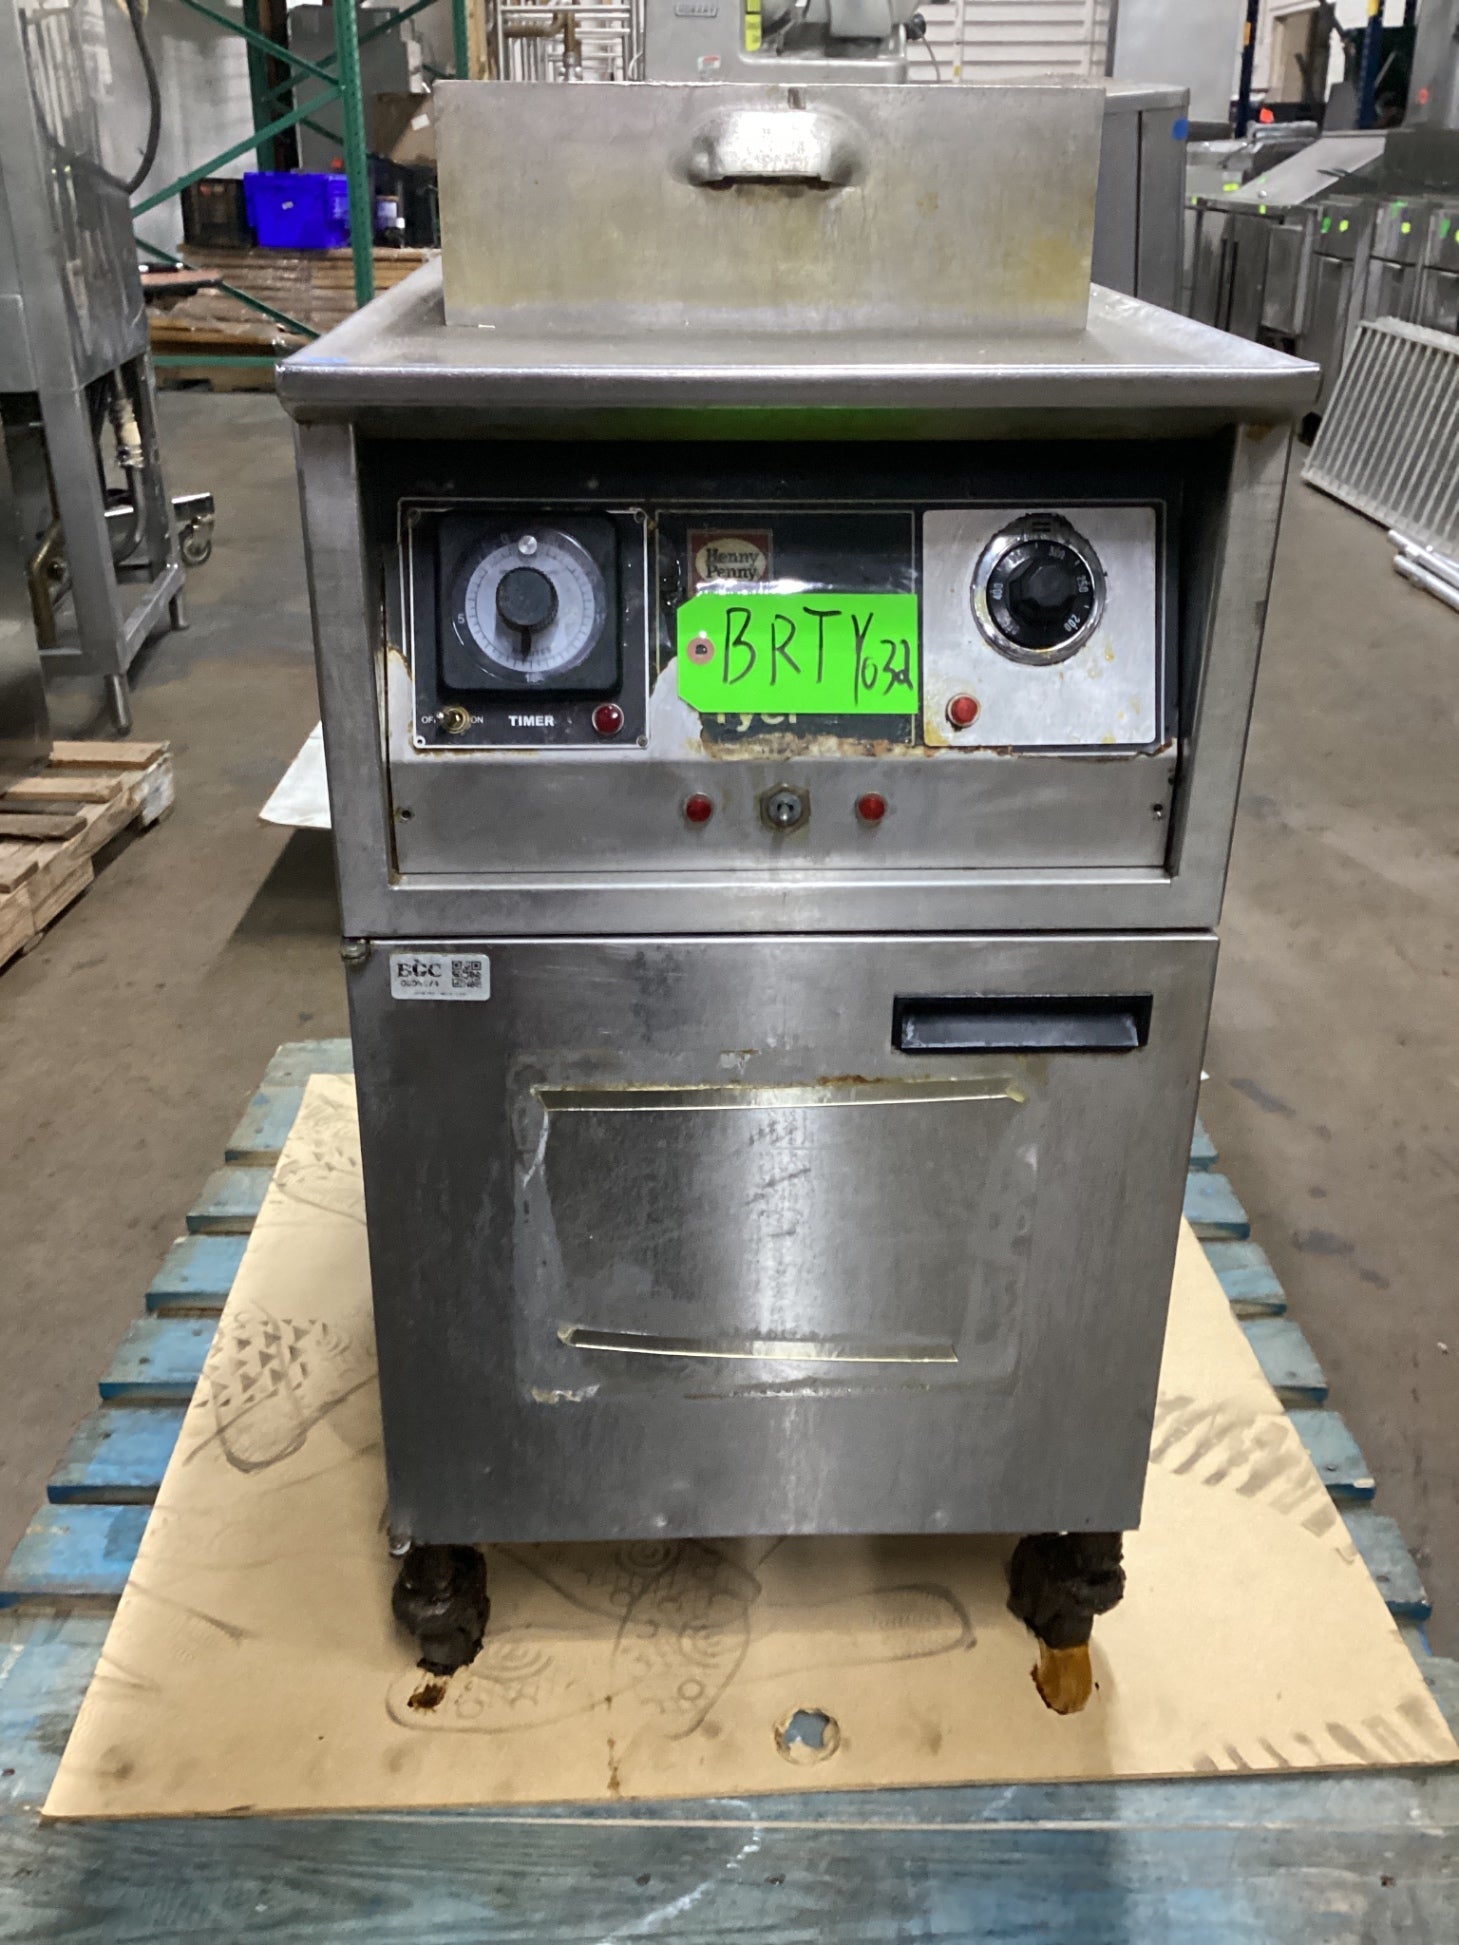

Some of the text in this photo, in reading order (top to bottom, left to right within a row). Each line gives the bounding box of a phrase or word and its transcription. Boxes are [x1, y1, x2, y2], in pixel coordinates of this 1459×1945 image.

[705, 549, 759, 566] Henny
[705, 564, 757, 580] Penny
[991, 583, 1003, 600] 400
[457, 613, 465, 624] 5
[1064, 615, 1080, 631] 200
[421, 716, 437, 724] OF
[471, 716, 484, 724] ON
[508, 715, 555, 727] TIMER
